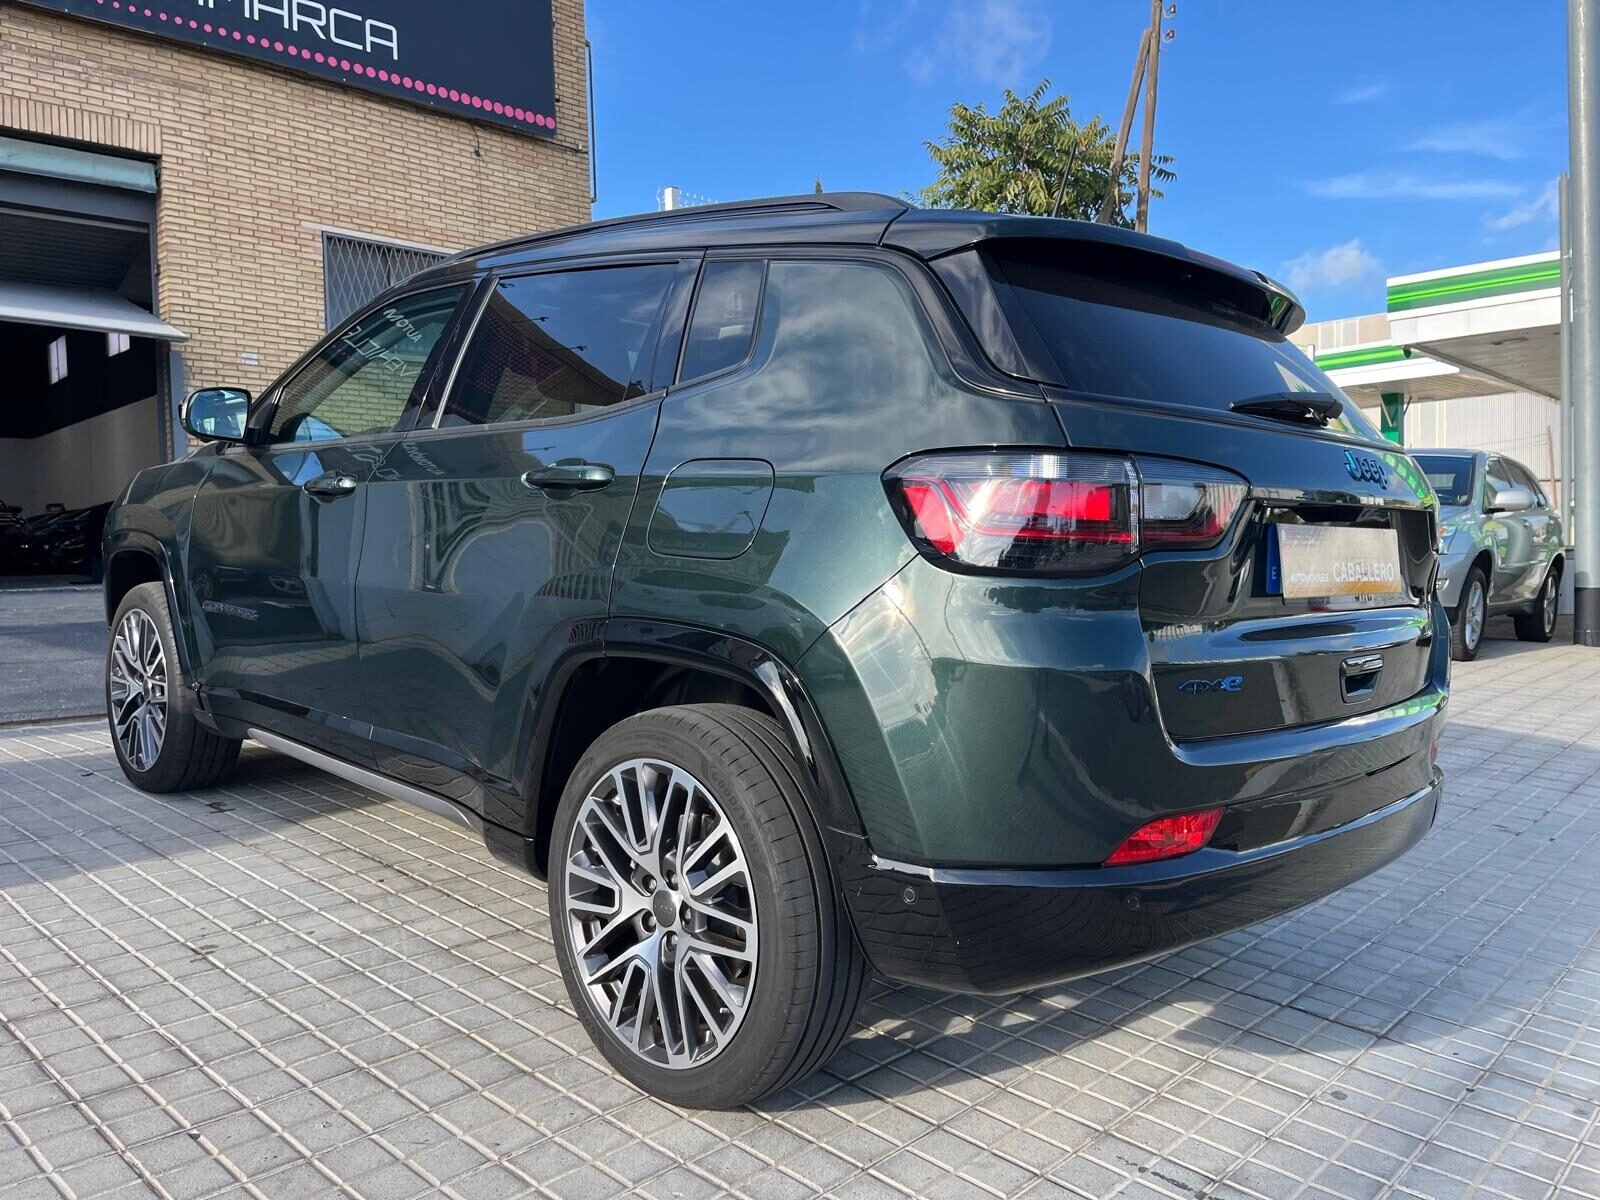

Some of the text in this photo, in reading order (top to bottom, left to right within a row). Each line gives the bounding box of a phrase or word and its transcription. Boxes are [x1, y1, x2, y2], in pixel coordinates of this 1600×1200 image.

[197, 0, 399, 61] ARCA
[1344, 449, 1388, 490] Jeep
[1332, 561, 1394, 582] CABALLERO
